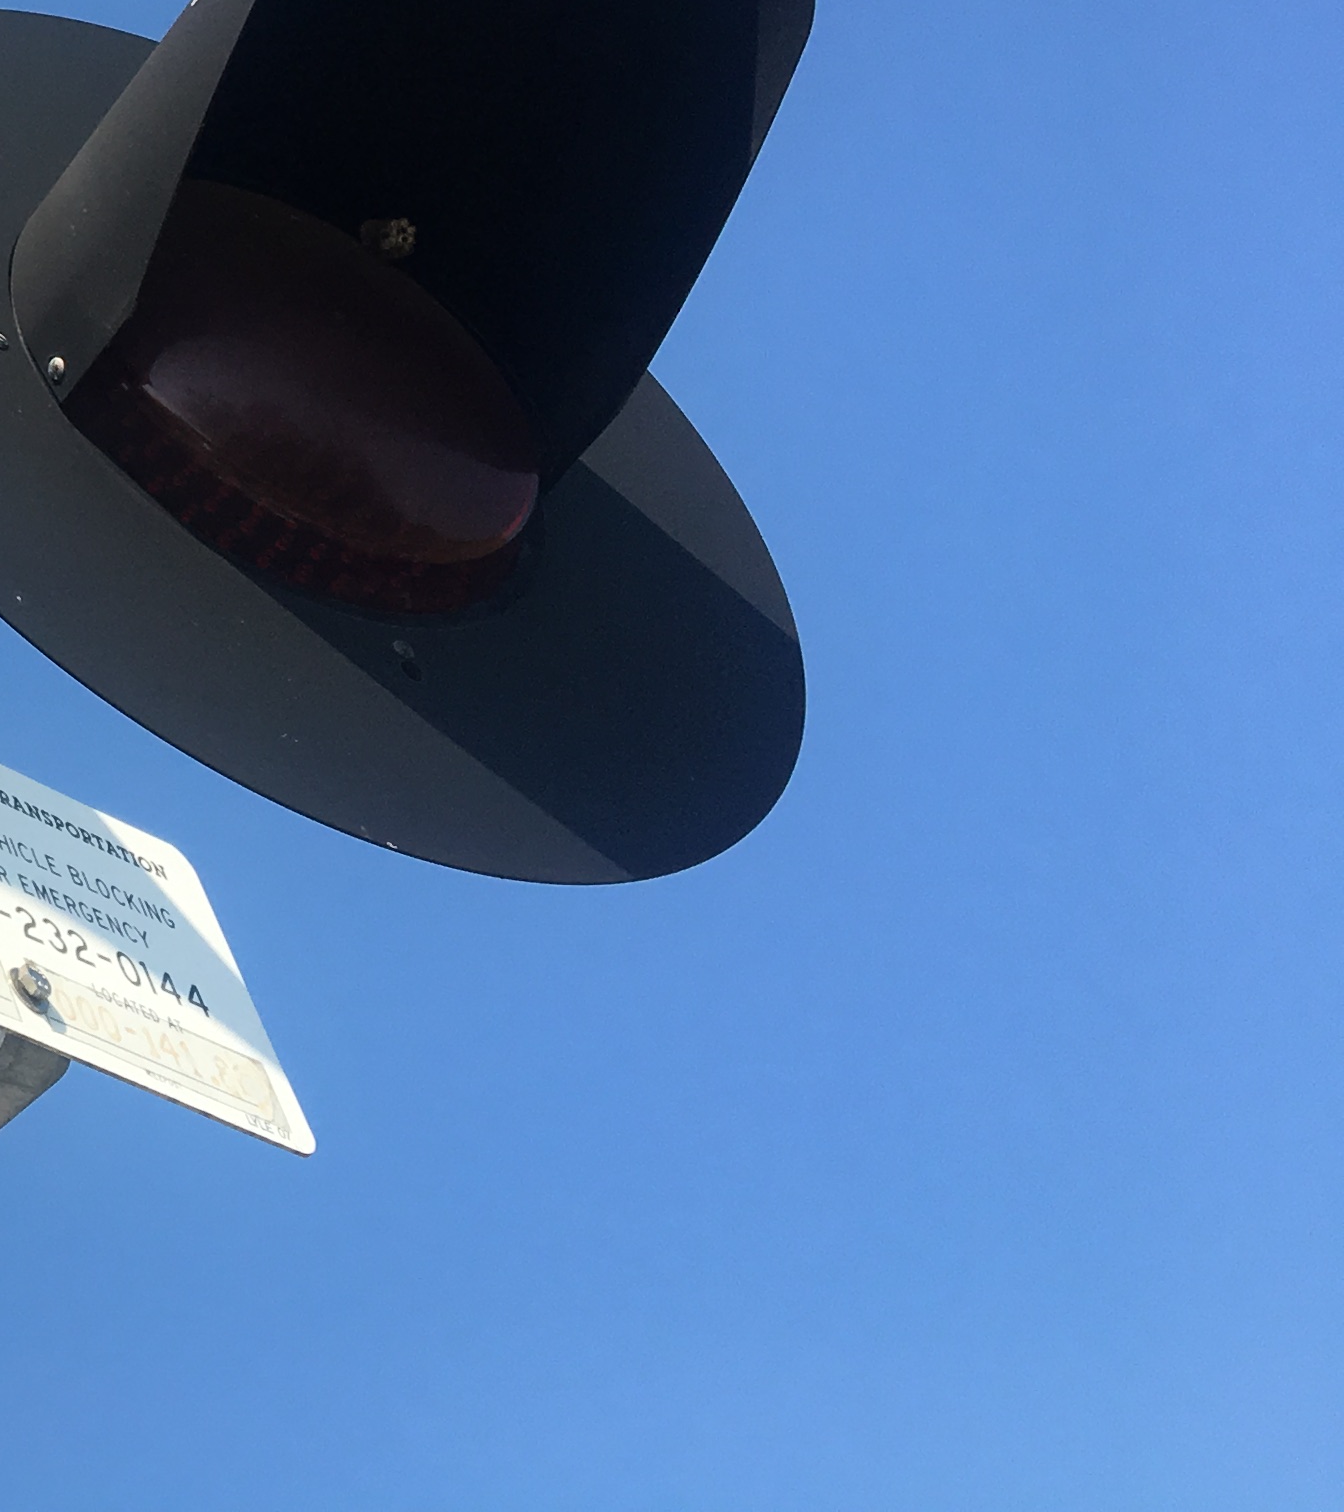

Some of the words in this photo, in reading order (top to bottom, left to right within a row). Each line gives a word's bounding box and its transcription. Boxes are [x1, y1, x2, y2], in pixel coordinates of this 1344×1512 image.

[18, 873, 150, 948] EMERGENCY
[67, 864, 176, 929] BLOCKING
[91, 983, 160, 1023] LOCATED
